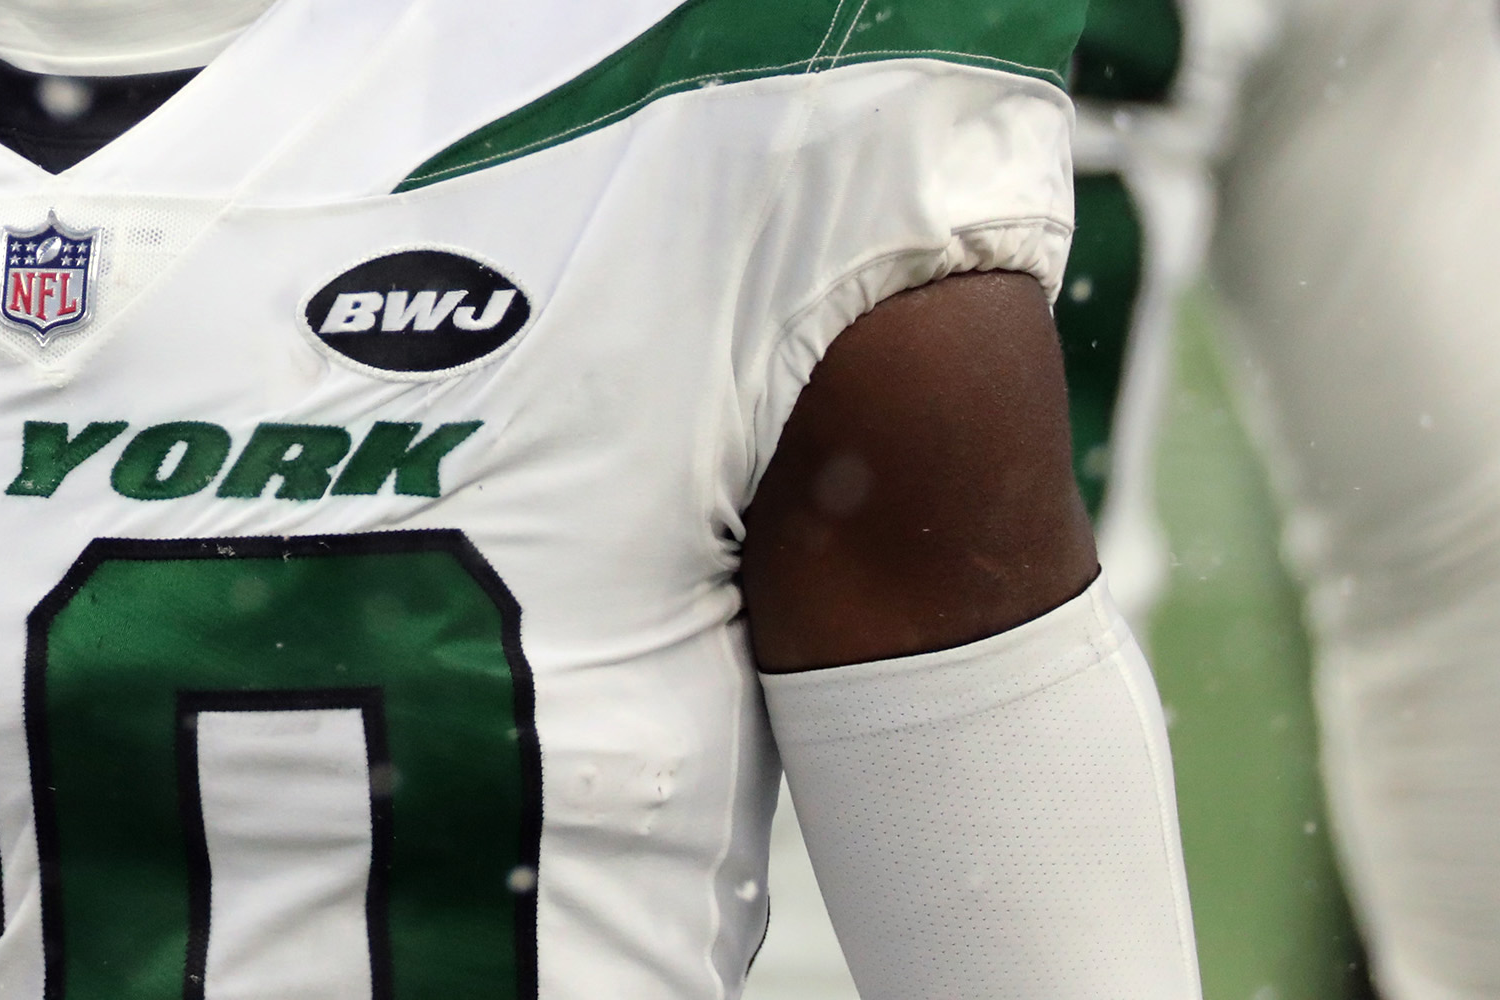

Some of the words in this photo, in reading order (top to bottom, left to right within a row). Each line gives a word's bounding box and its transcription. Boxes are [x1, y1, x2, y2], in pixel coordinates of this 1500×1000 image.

[9, 271, 78, 321] NFL
[318, 288, 518, 334] BWJ
[4, 419, 486, 501] YORK
